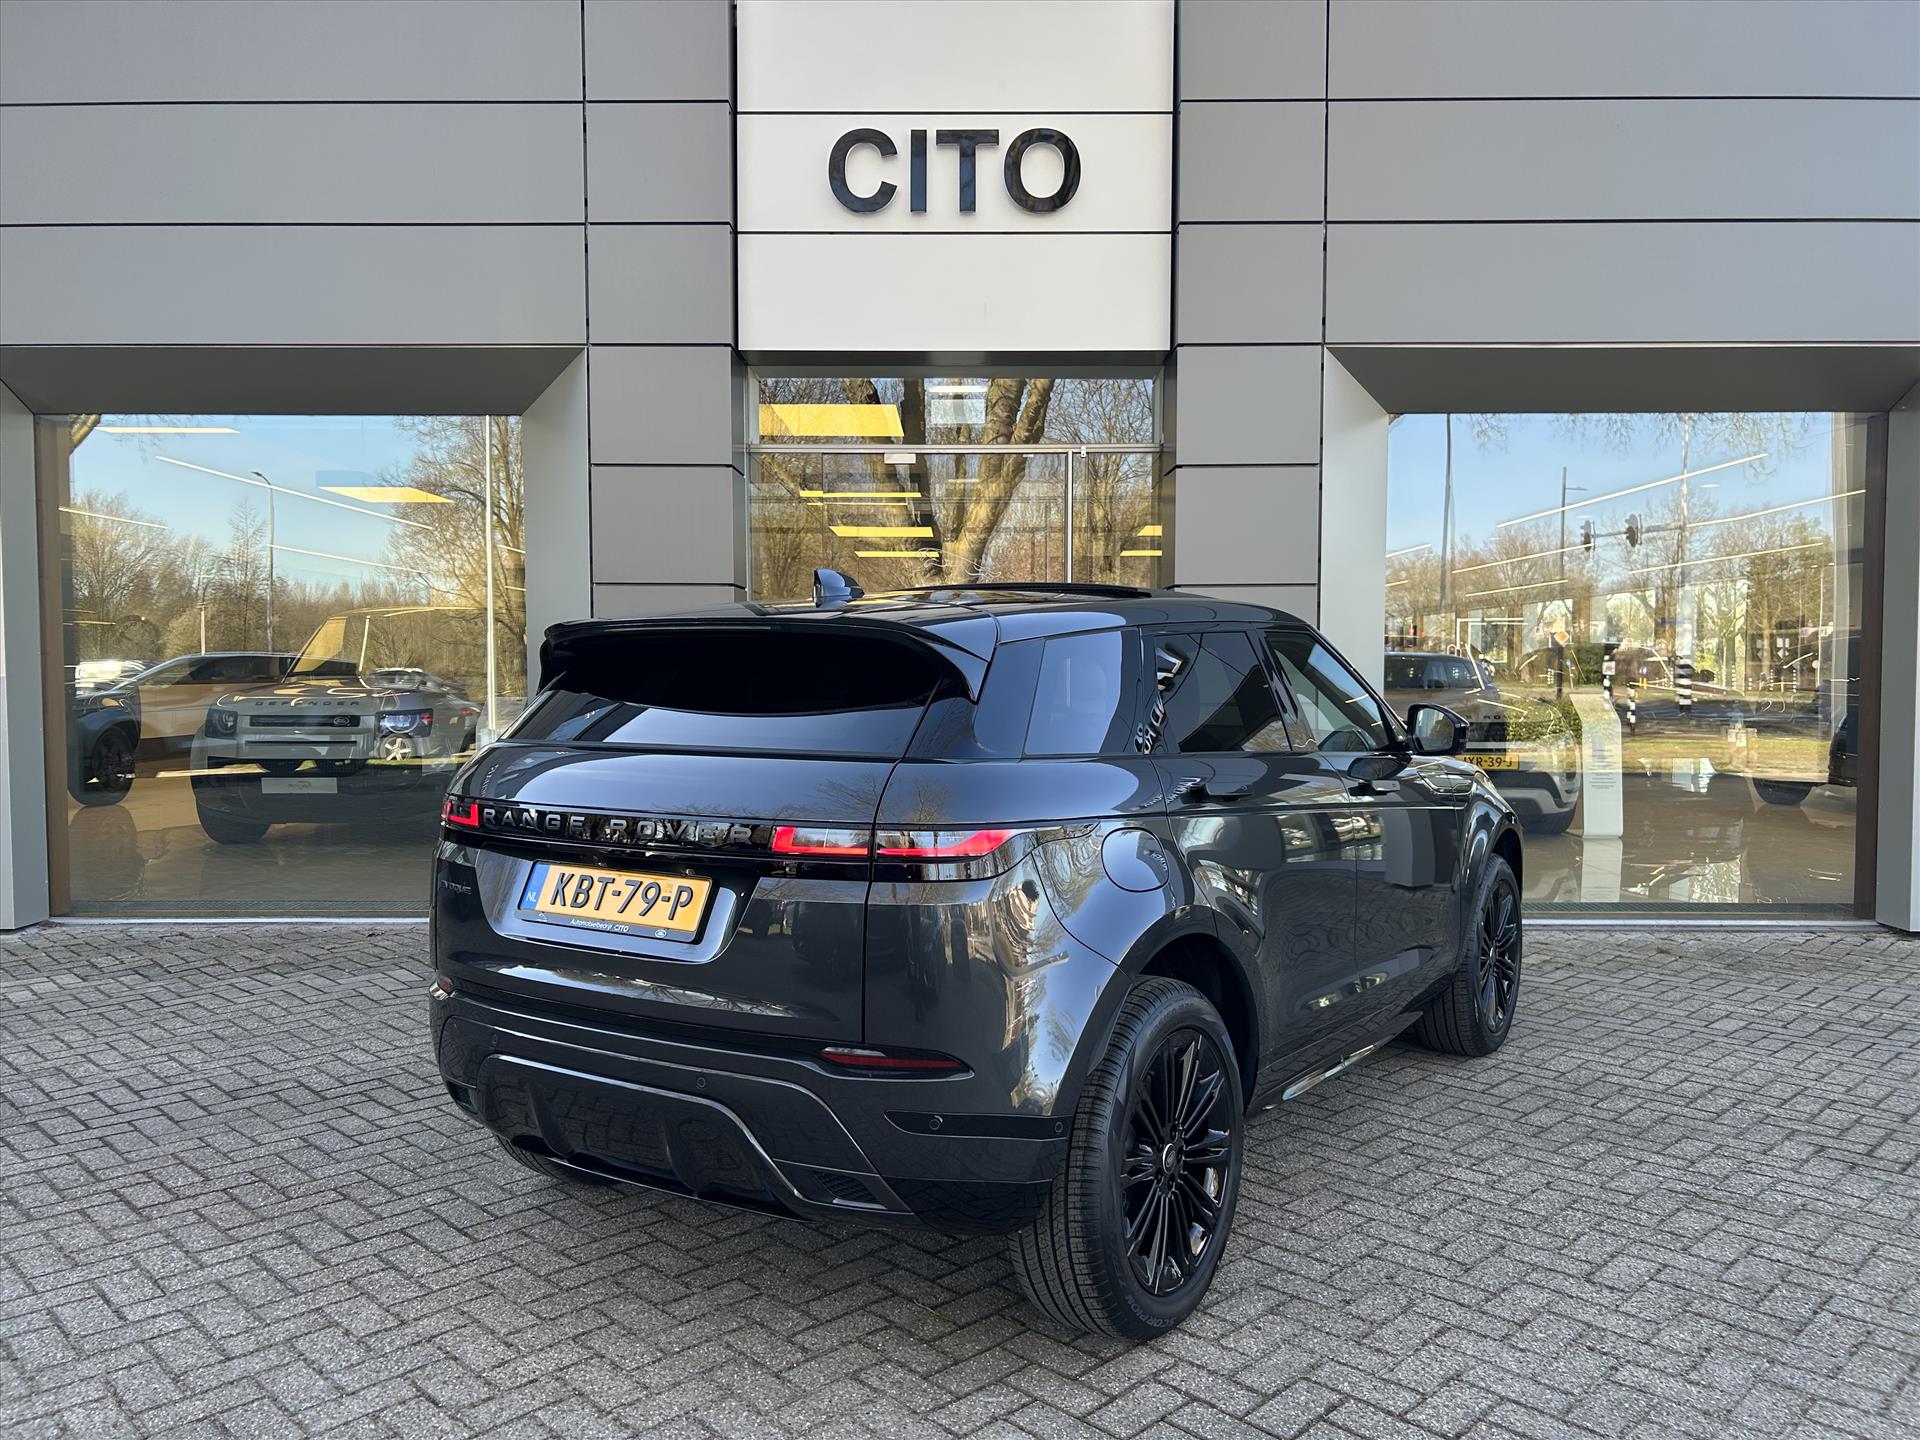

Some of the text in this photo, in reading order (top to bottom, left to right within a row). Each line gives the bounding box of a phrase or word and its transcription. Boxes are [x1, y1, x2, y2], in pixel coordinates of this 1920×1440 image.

[828, 127, 1081, 213] CITO
[483, 808, 752, 844] RANGE ROVER
[526, 891, 537, 902] NL
[549, 872, 694, 921] KBT-79-P
[1124, 1294, 1177, 1328] SCORPION
